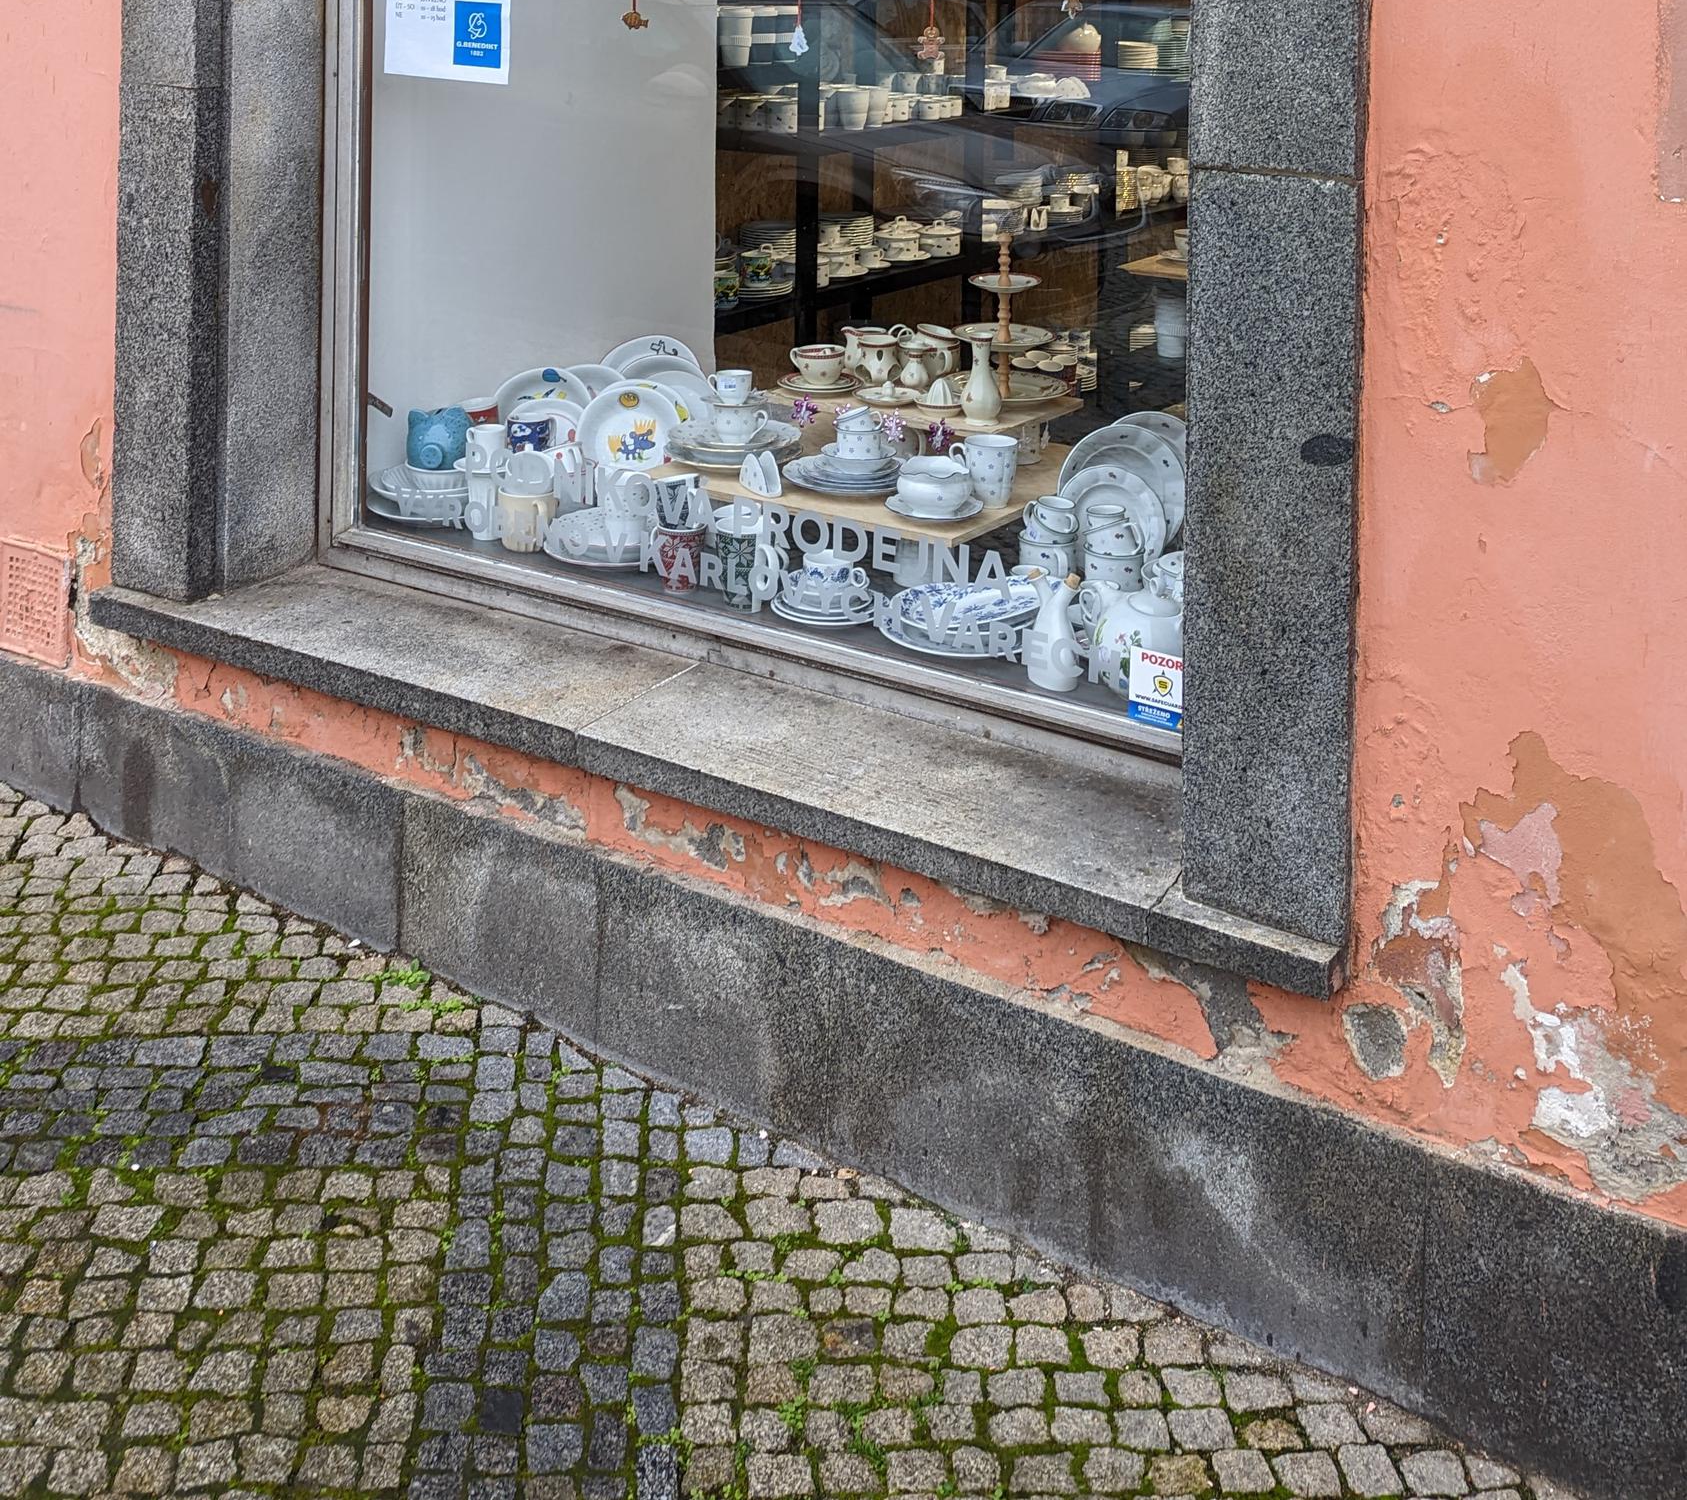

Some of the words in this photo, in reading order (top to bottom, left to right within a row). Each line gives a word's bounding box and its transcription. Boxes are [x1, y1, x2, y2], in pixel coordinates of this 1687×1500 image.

[597, 530, 628, 562] V
[733, 495, 1011, 601] PRODEJNA
[1141, 652, 1184, 671] POZOR
